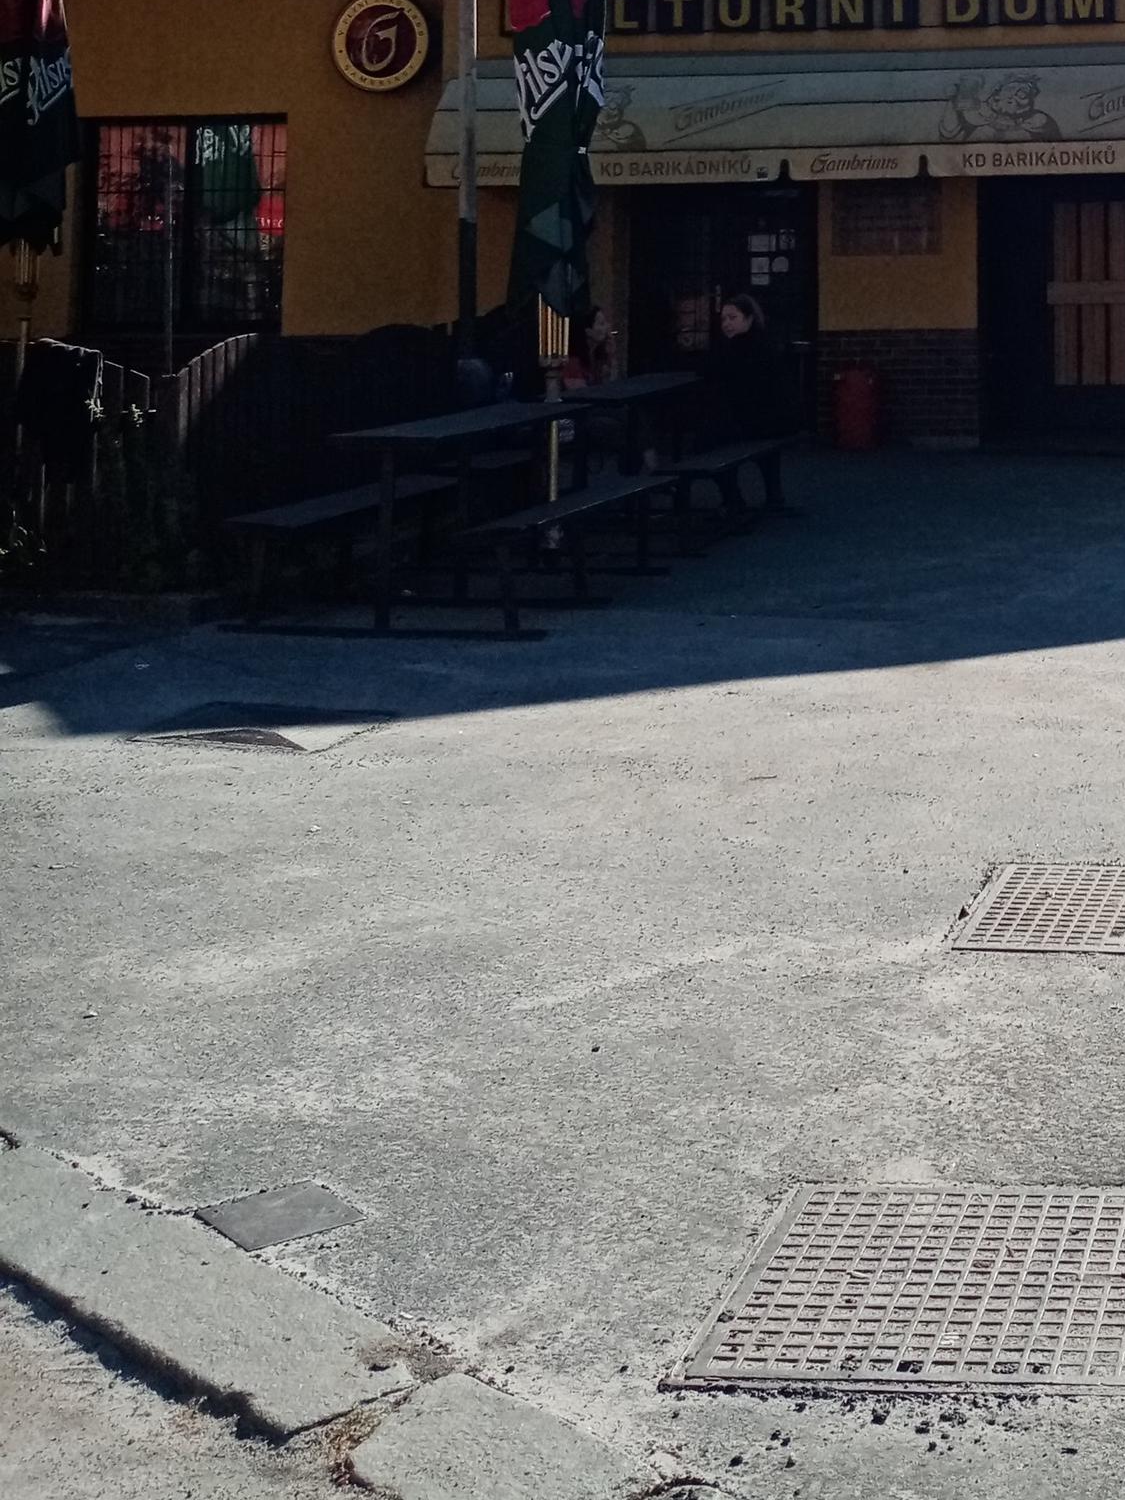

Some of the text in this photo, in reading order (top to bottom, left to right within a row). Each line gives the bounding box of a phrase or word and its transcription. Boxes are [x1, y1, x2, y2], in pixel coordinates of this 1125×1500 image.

[600, 162, 624, 177] KD
[629, 155, 751, 177] BARIKÁDNÍKŮ
[810, 153, 899, 176] Gambrinus
[962, 145, 1116, 169] KD BARIKÁDNÍKŮ
